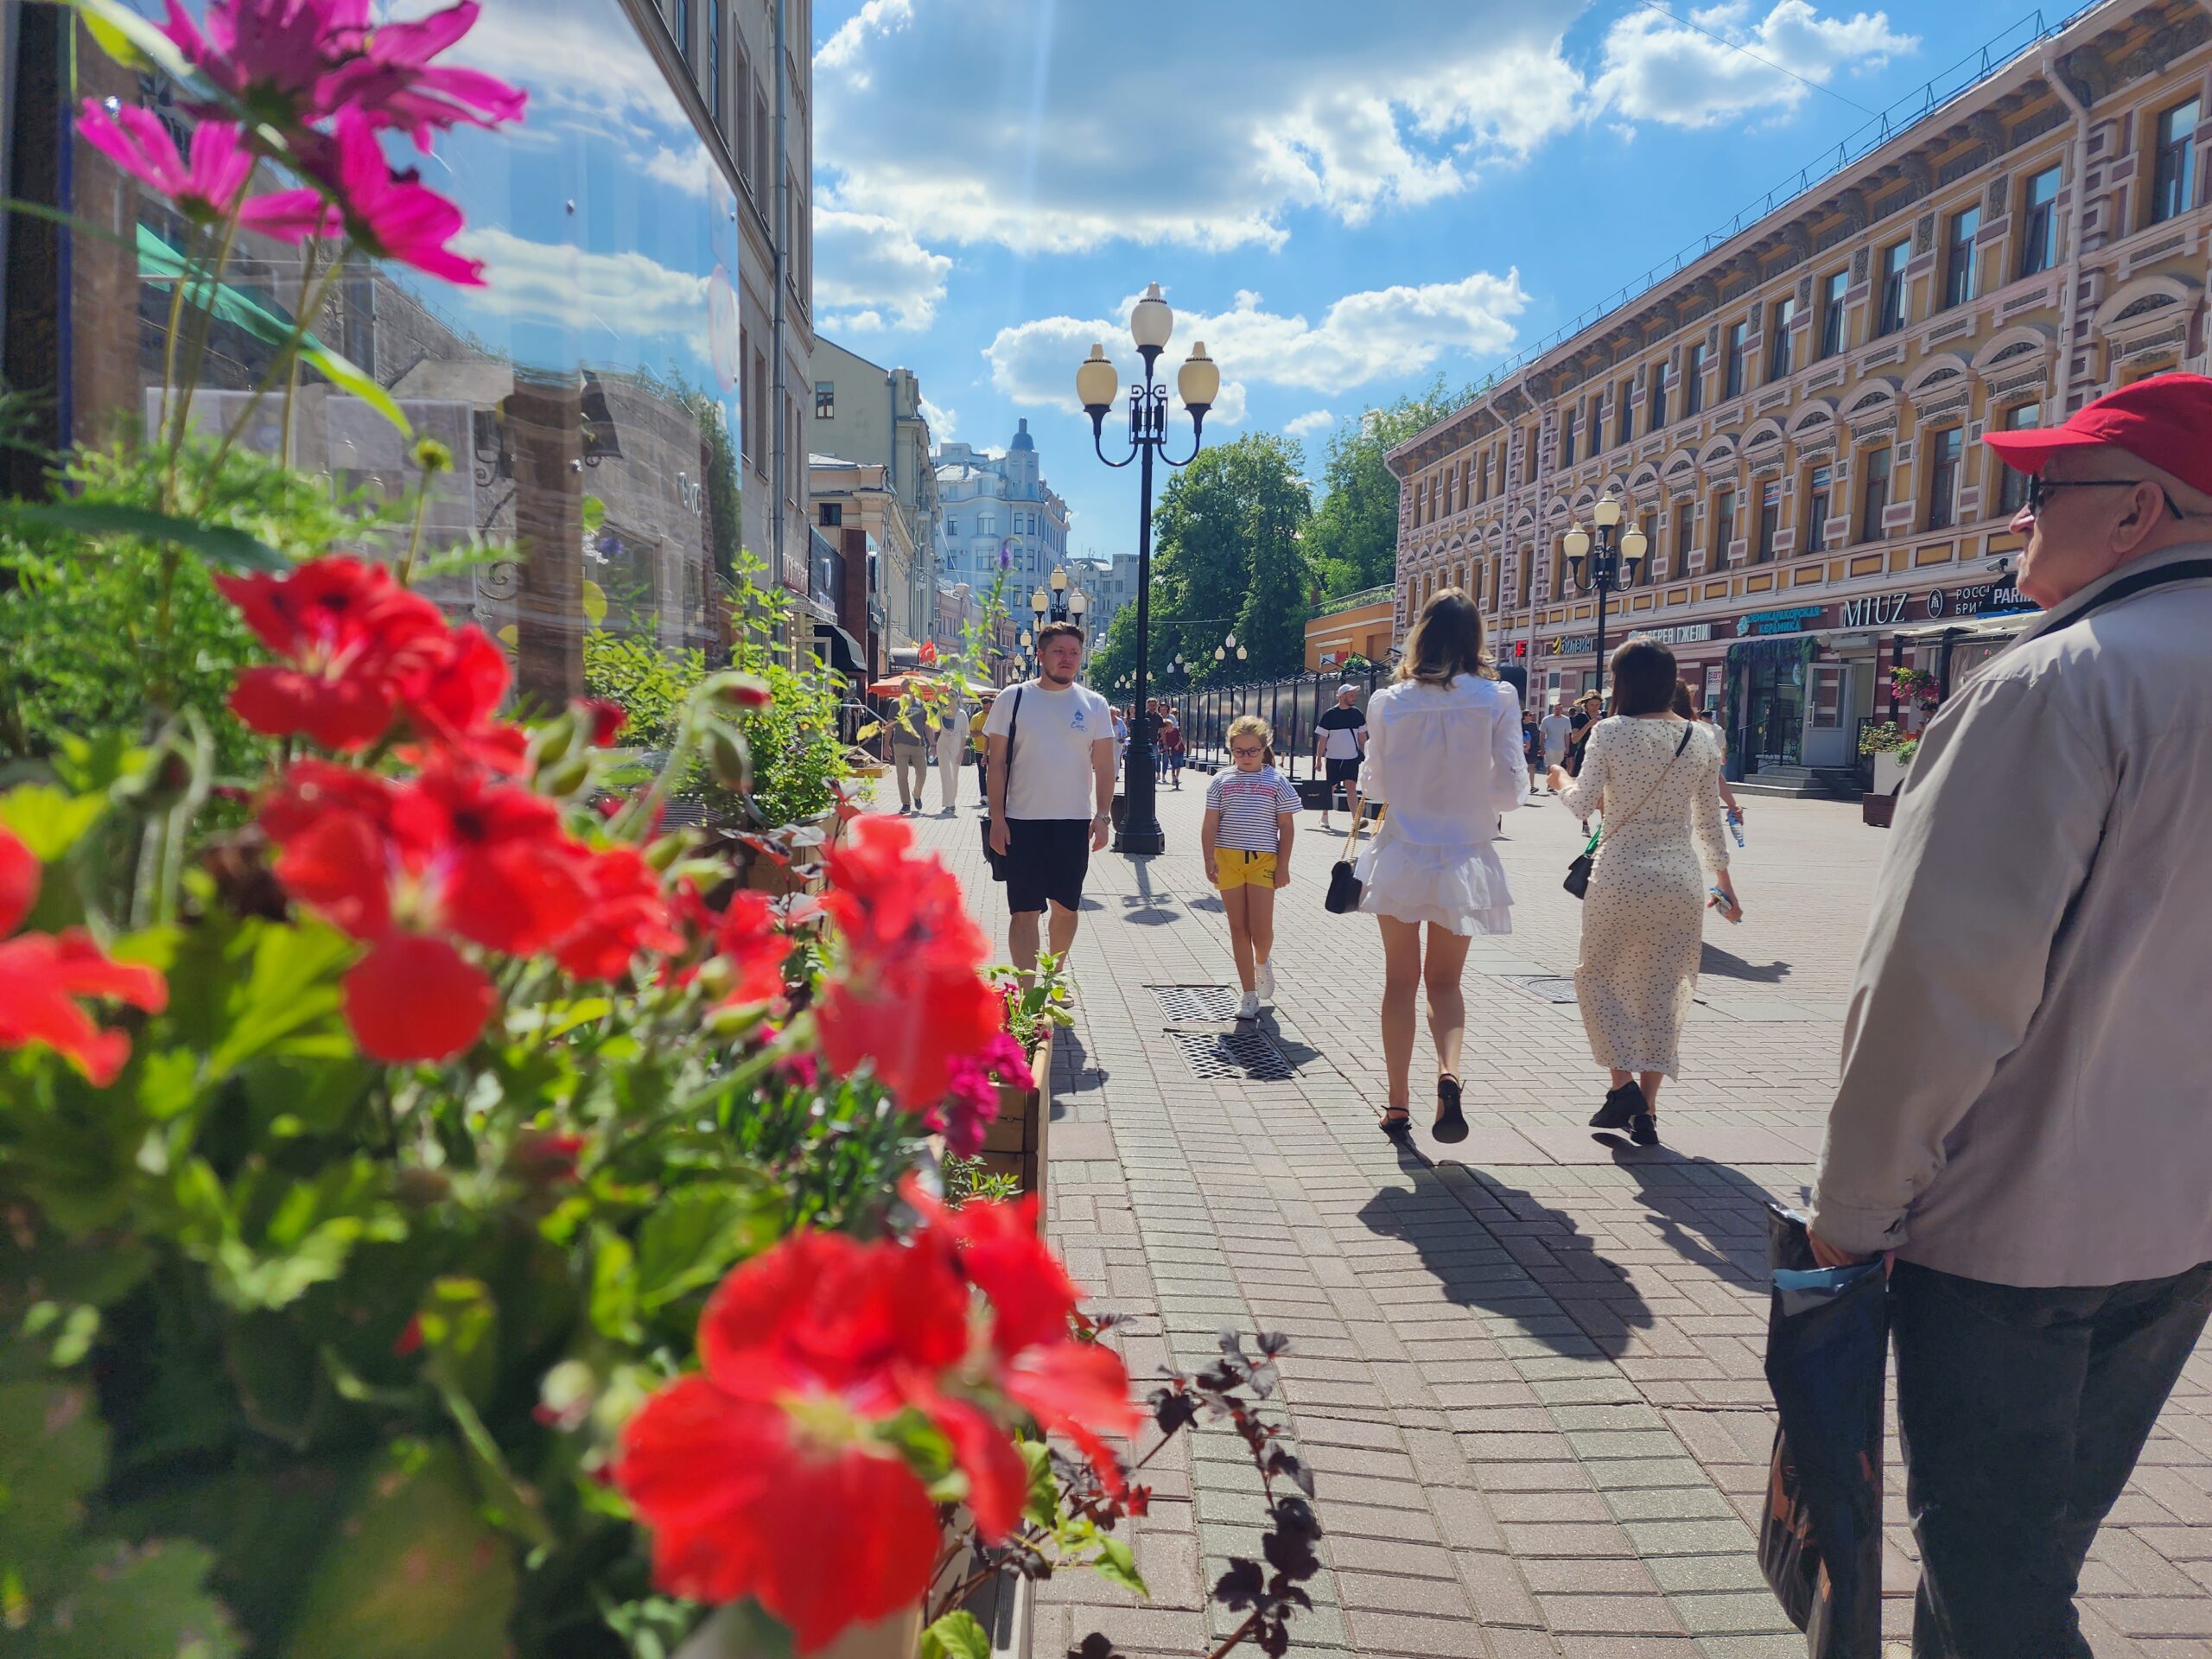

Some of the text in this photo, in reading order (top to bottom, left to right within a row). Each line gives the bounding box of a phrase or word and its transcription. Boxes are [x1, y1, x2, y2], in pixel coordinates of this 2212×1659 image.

[1842, 593, 1908, 626] MIUZ
[1676, 624, 1708, 643] ГЖЕЛИ
[1759, 620, 1801, 635] КЕРАМИКА
[1561, 634, 1593, 654] билайн
